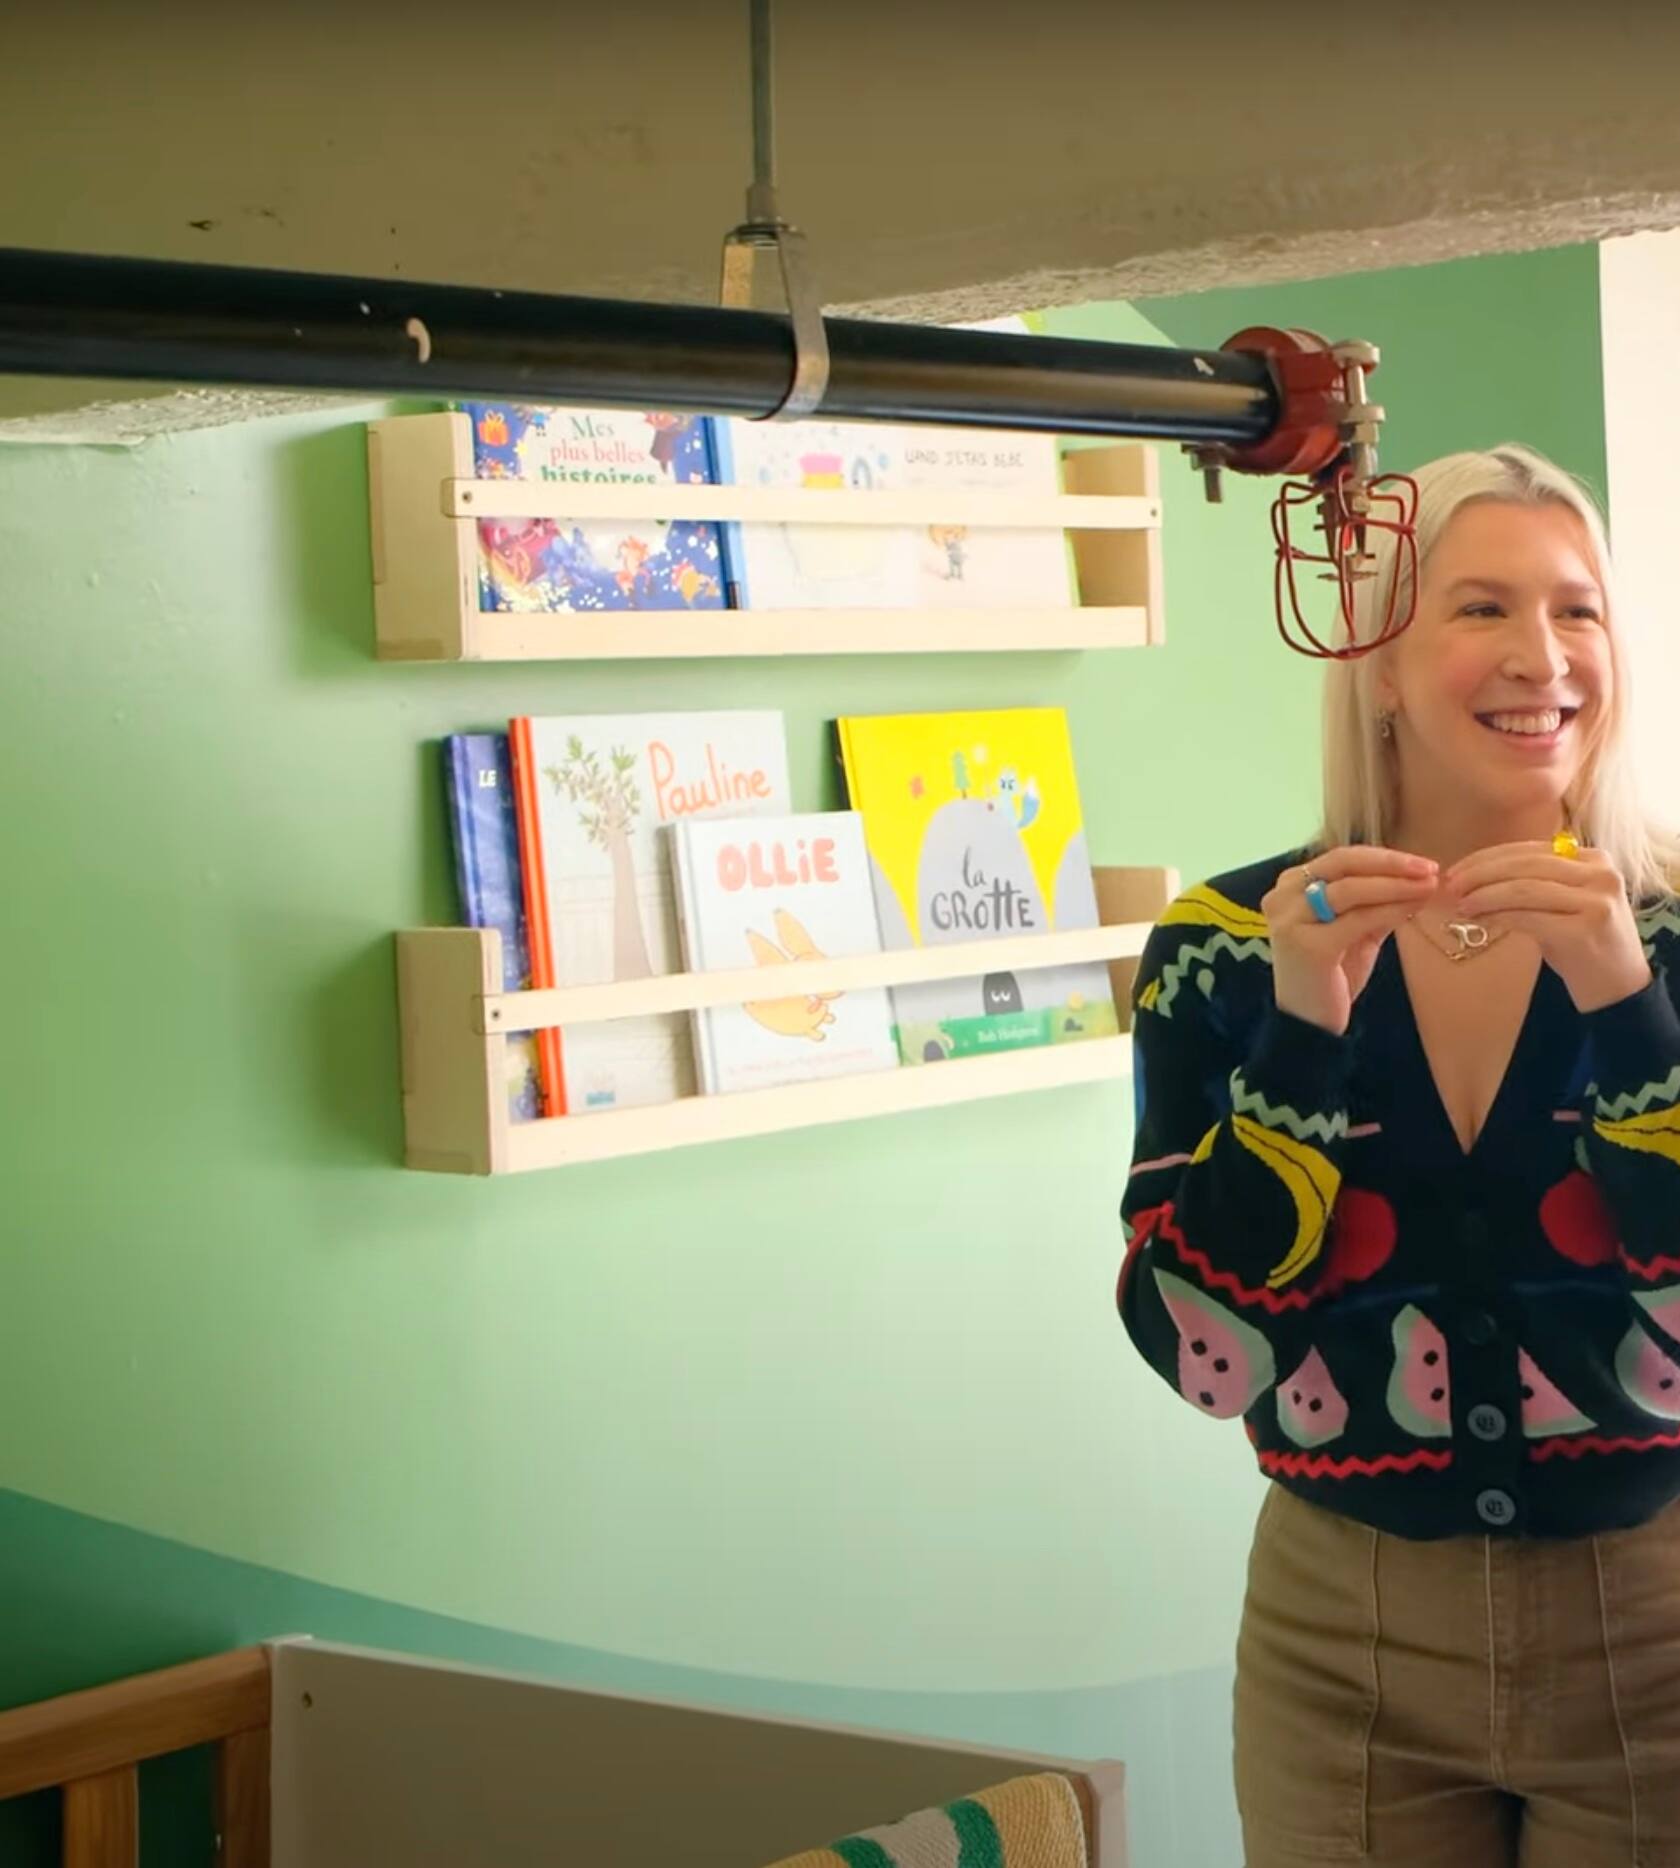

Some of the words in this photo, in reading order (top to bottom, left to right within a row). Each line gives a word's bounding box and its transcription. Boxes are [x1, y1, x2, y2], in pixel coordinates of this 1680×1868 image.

[570, 415, 614, 440] Mes
[550, 439, 589, 466] plus
[593, 440, 646, 464] belles
[540, 465, 656, 485] histoires
[479, 769, 496, 788] LE
[646, 740, 773, 821] Pauline
[962, 844, 987, 889] la
